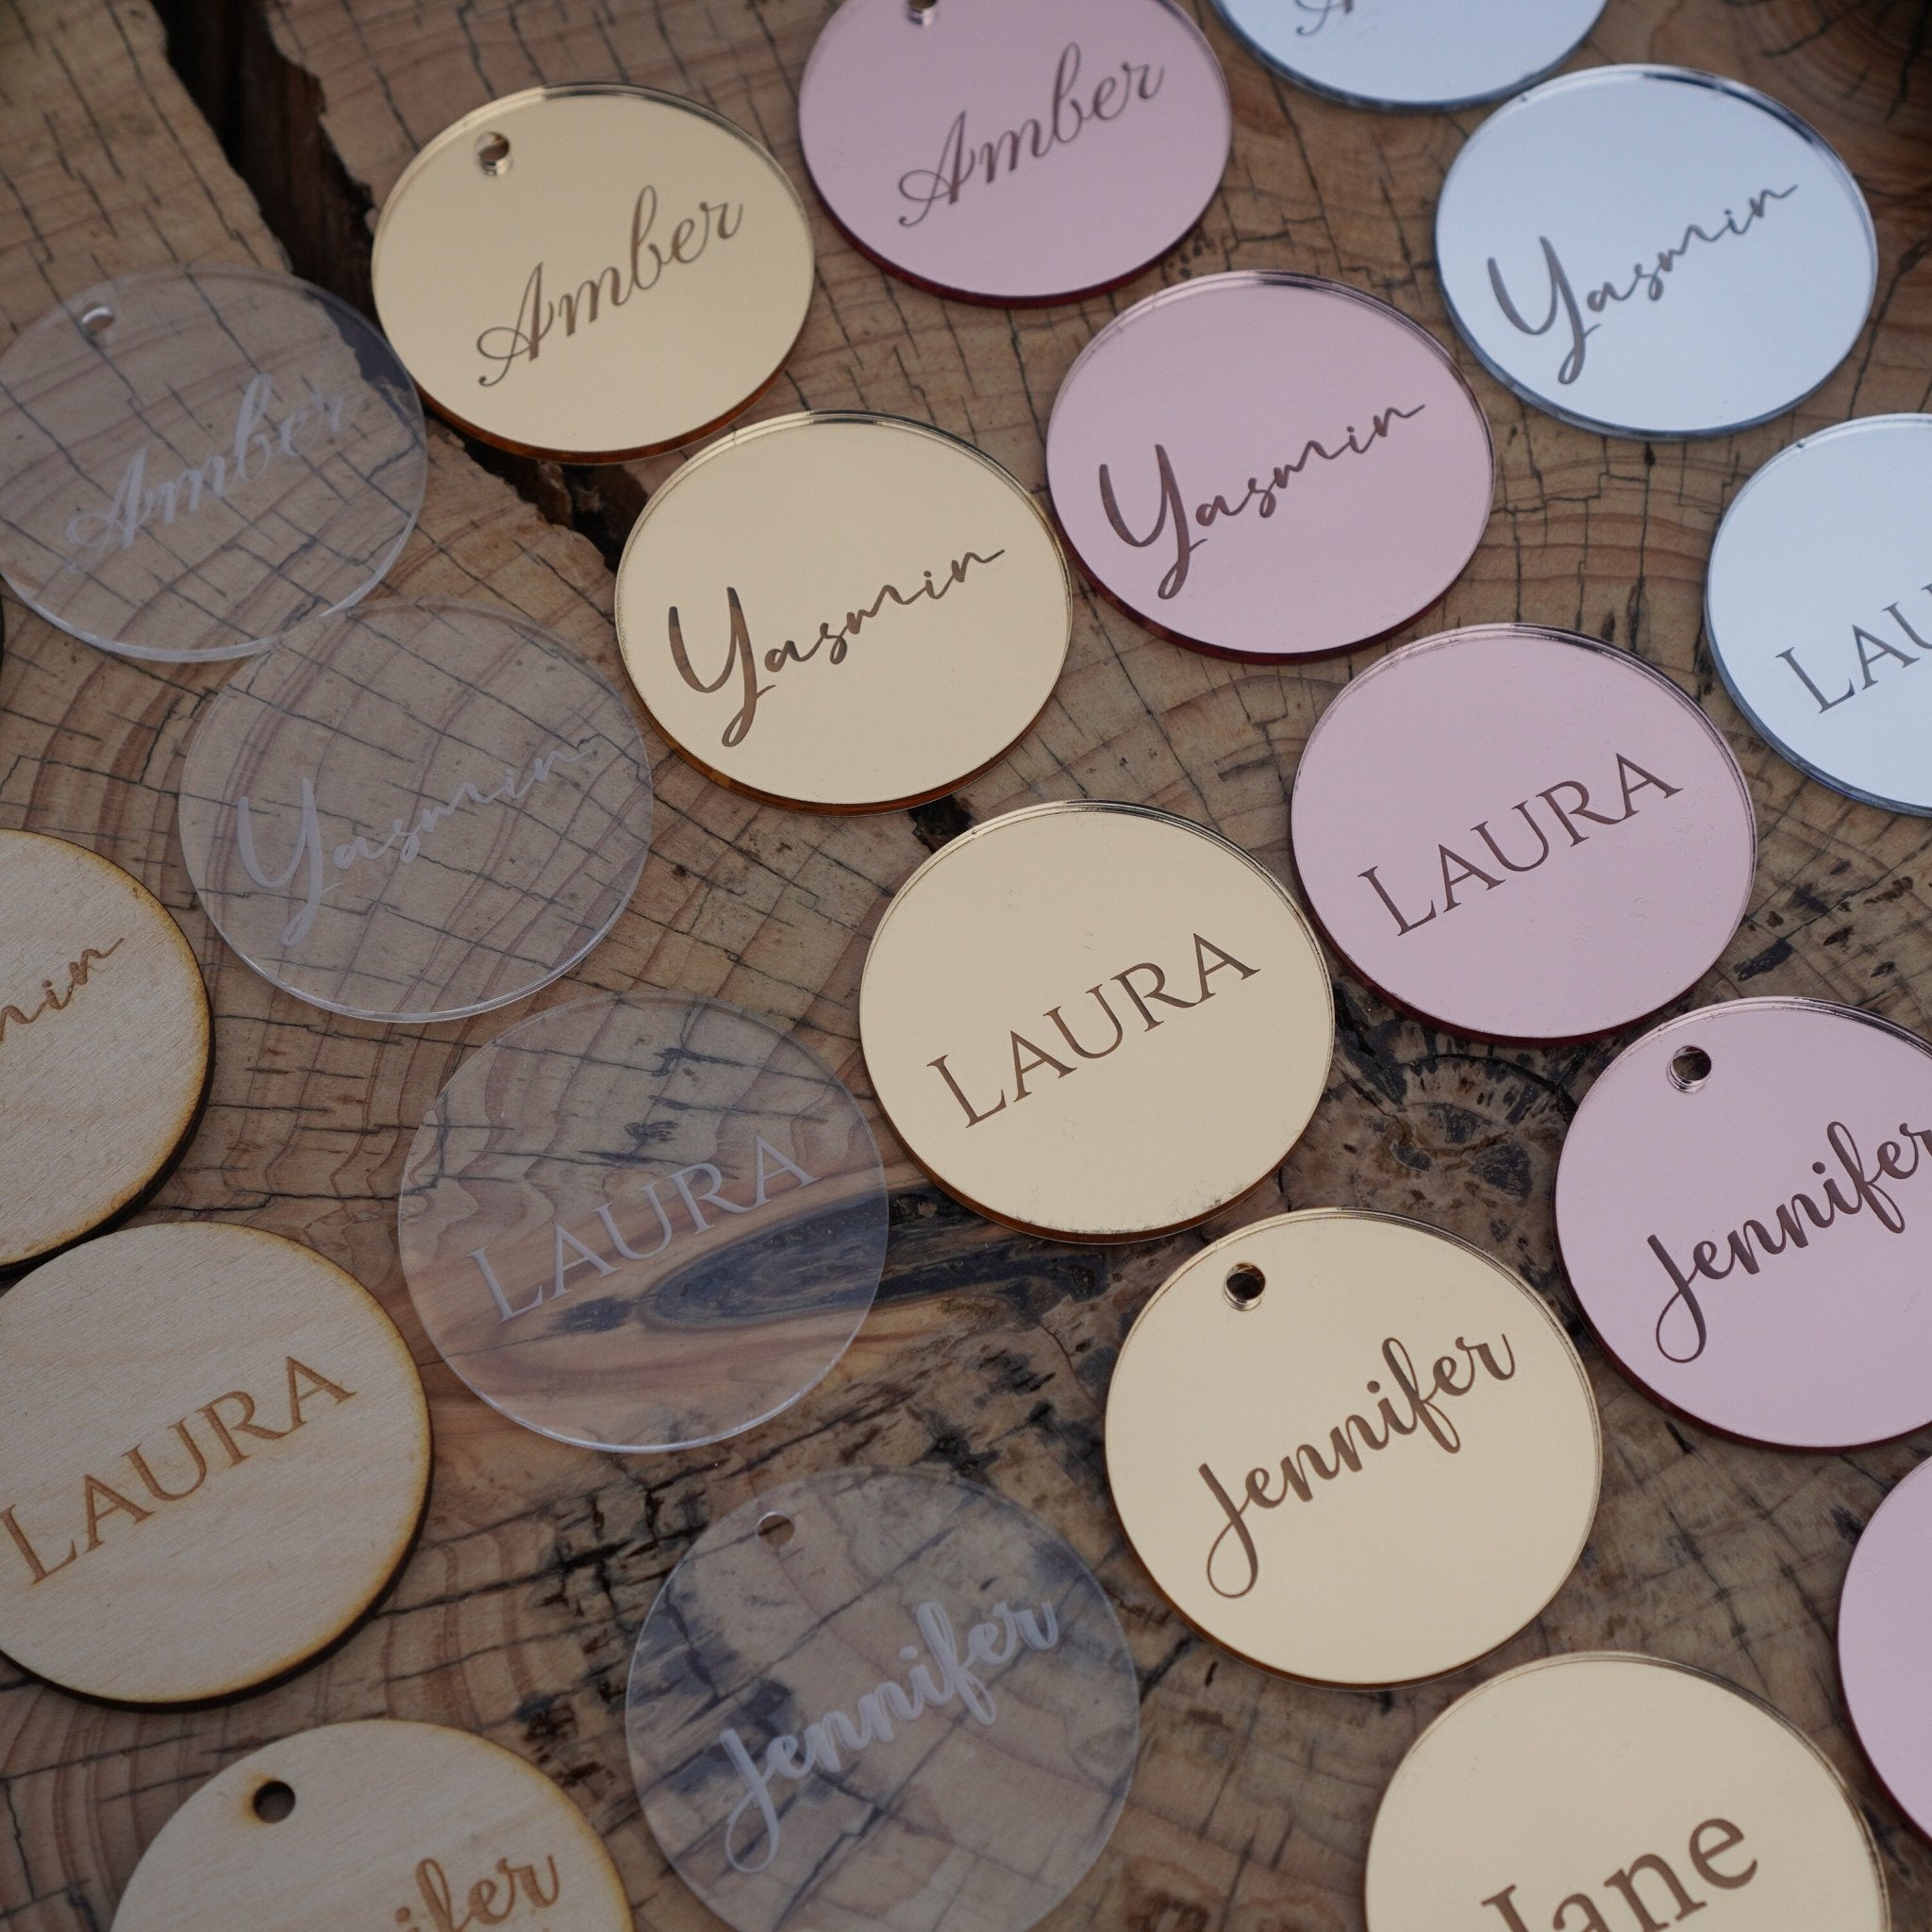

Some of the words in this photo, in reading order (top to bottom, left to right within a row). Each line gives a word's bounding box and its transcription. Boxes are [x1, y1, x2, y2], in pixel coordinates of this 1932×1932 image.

[897, 42, 1165, 227] Amber
[475, 184, 744, 387] Amber
[1487, 184, 1799, 386] Yasmin
[65, 373, 352, 575] Amber
[1099, 404, 1426, 601] Yasmin
[666, 548, 1006, 749] Yasmin
[237, 749, 593, 947] Yasmin
[1357, 752, 1684, 937] LAURA
[925, 932, 1261, 1129] LAURA
[466, 1134, 823, 1324] LAURA
[0, 1355, 358, 1587] LAURA
[1198, 1333, 1516, 1600] Jennifer
[719, 1599, 1059, 1874] Jennifer
